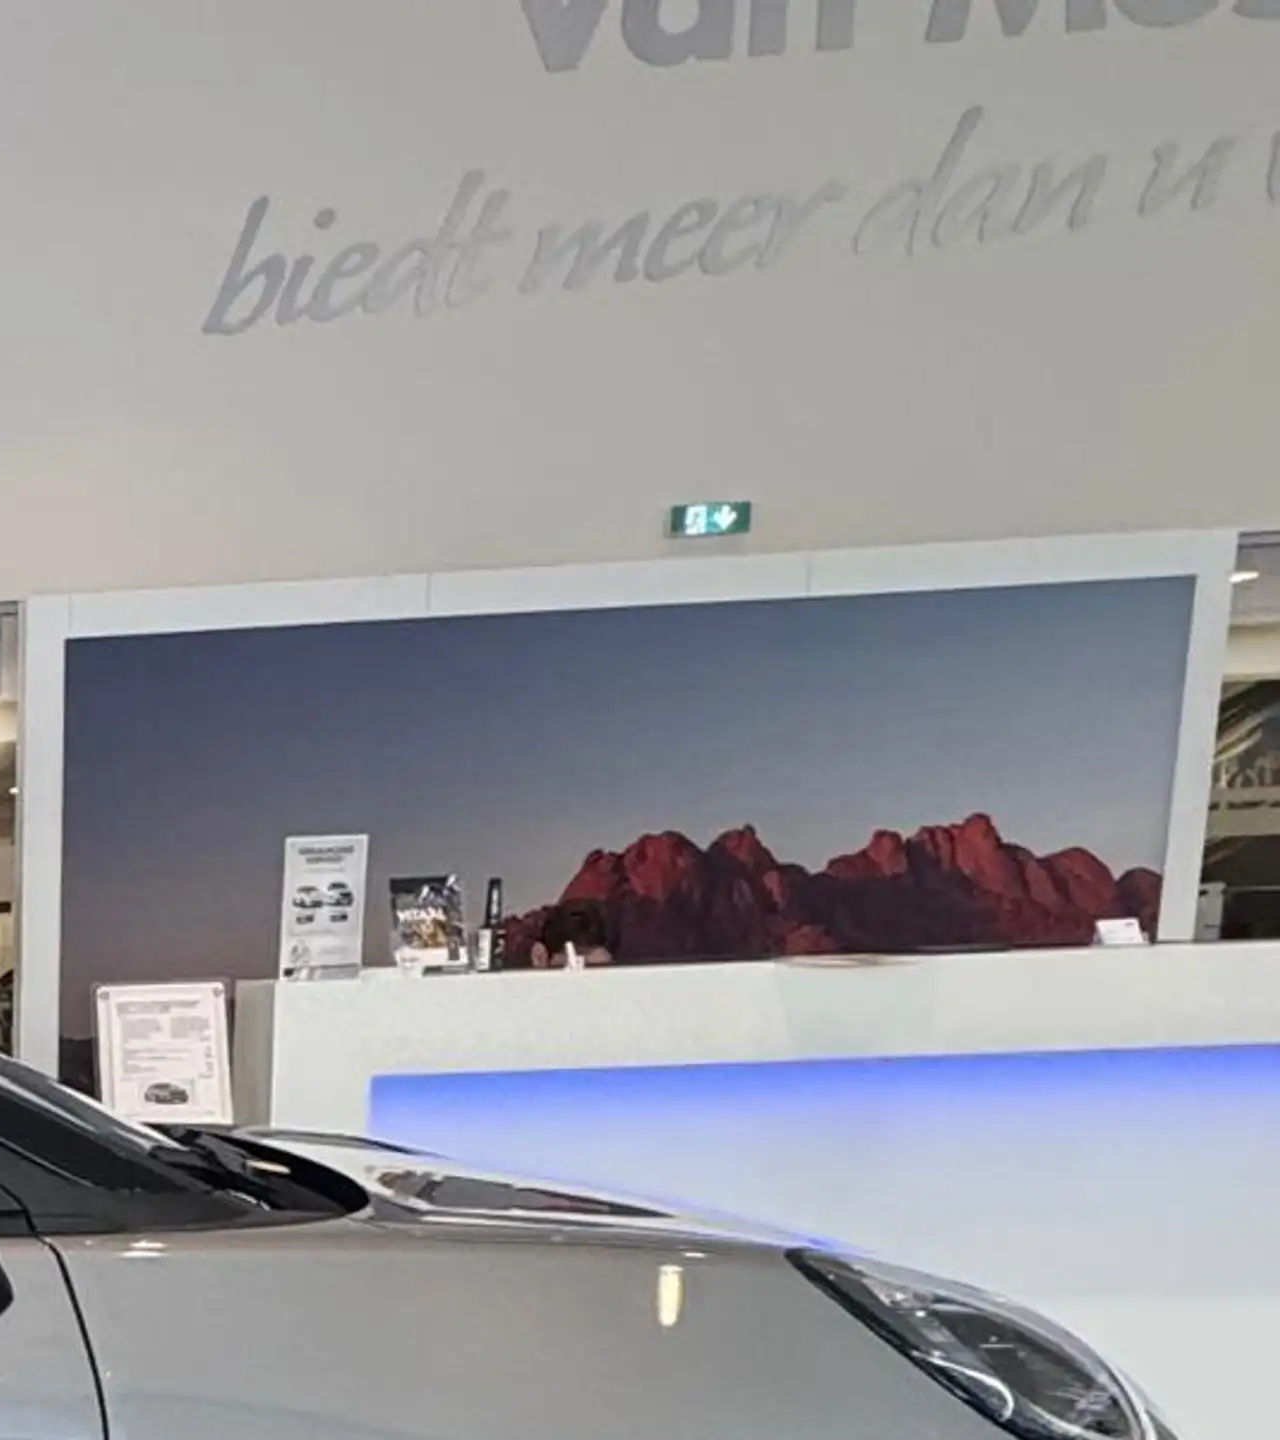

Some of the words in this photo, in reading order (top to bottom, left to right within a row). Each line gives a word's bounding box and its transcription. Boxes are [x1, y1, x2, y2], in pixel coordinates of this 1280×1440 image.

[200, 168, 510, 337] biedt
[516, 181, 850, 297] meer
[850, 105, 1108, 260] dan
[1136, 137, 1236, 218] u
